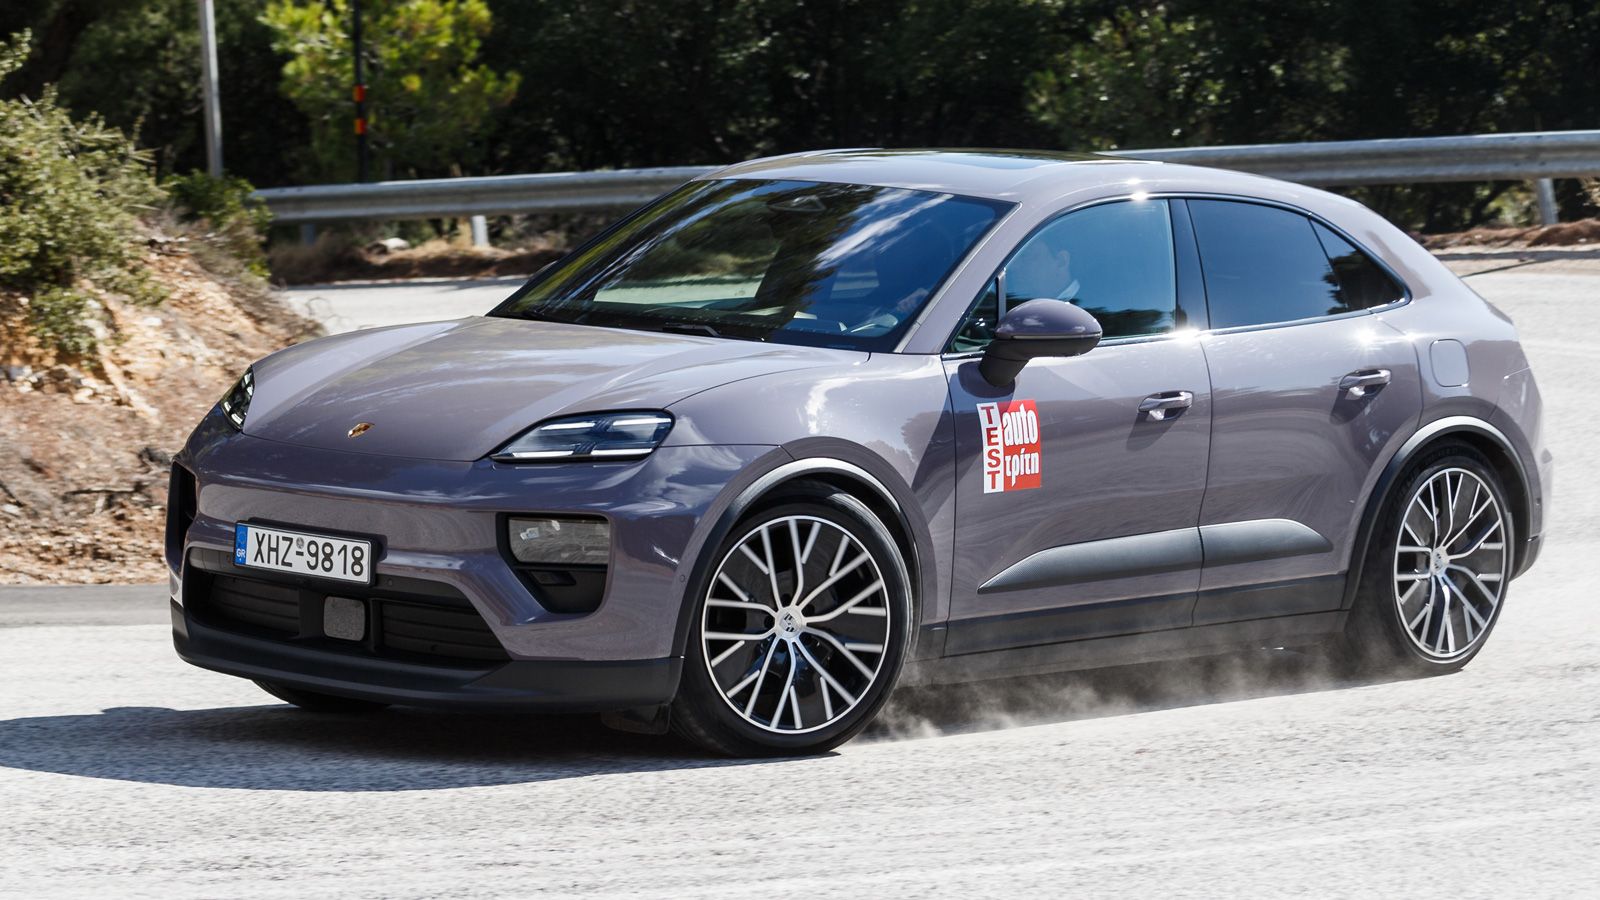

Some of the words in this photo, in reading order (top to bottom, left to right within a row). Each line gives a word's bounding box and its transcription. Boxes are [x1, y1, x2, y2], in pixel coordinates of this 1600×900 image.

[1002, 403, 1039, 447] auto
[981, 405, 1001, 490] TEST
[1005, 447, 1040, 488] τρίτη
[236, 548, 246, 558] GR
[253, 531, 365, 577] XHZ-9818
